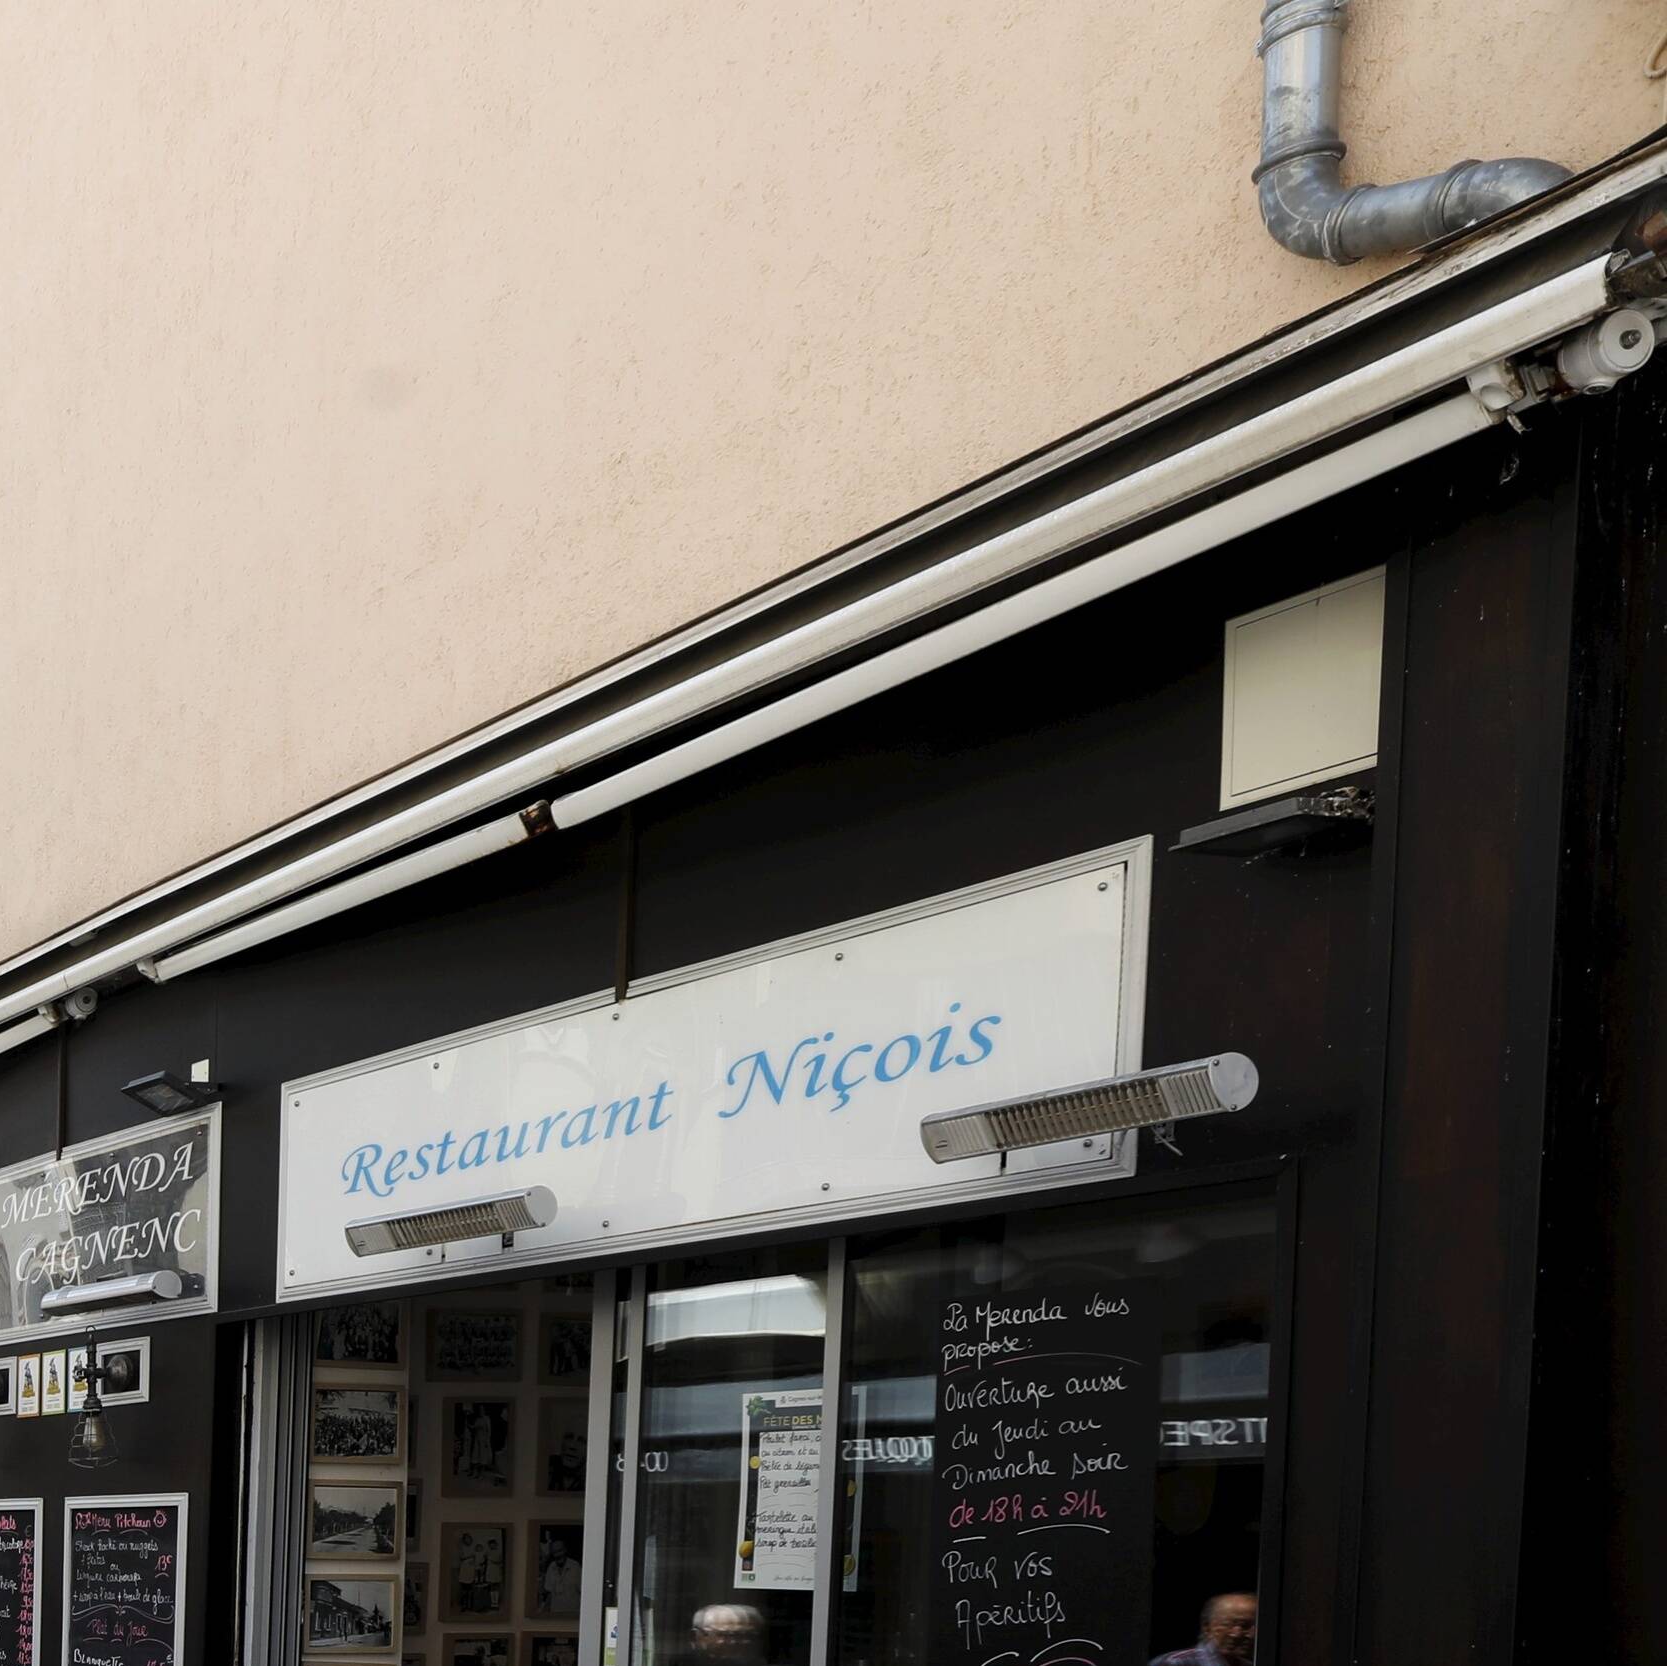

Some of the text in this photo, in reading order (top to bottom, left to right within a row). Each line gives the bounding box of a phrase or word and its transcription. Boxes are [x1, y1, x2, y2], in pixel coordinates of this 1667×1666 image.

[341, 1001, 1001, 1197] Restaurant Niçois
[1, 1142, 194, 1228] MÉRENDA
[15, 1208, 201, 1284] CAGNENC
[944, 1367, 1129, 1413] Ouverture aussi
[763, 1414, 791, 1426] FÊTE
[792, 1414, 813, 1425] DES
[951, 1424, 979, 1450] du
[1058, 1418, 1103, 1434] au
[941, 1450, 1057, 1490] Dimanche
[948, 1489, 1108, 1529] de 18h à 21h
